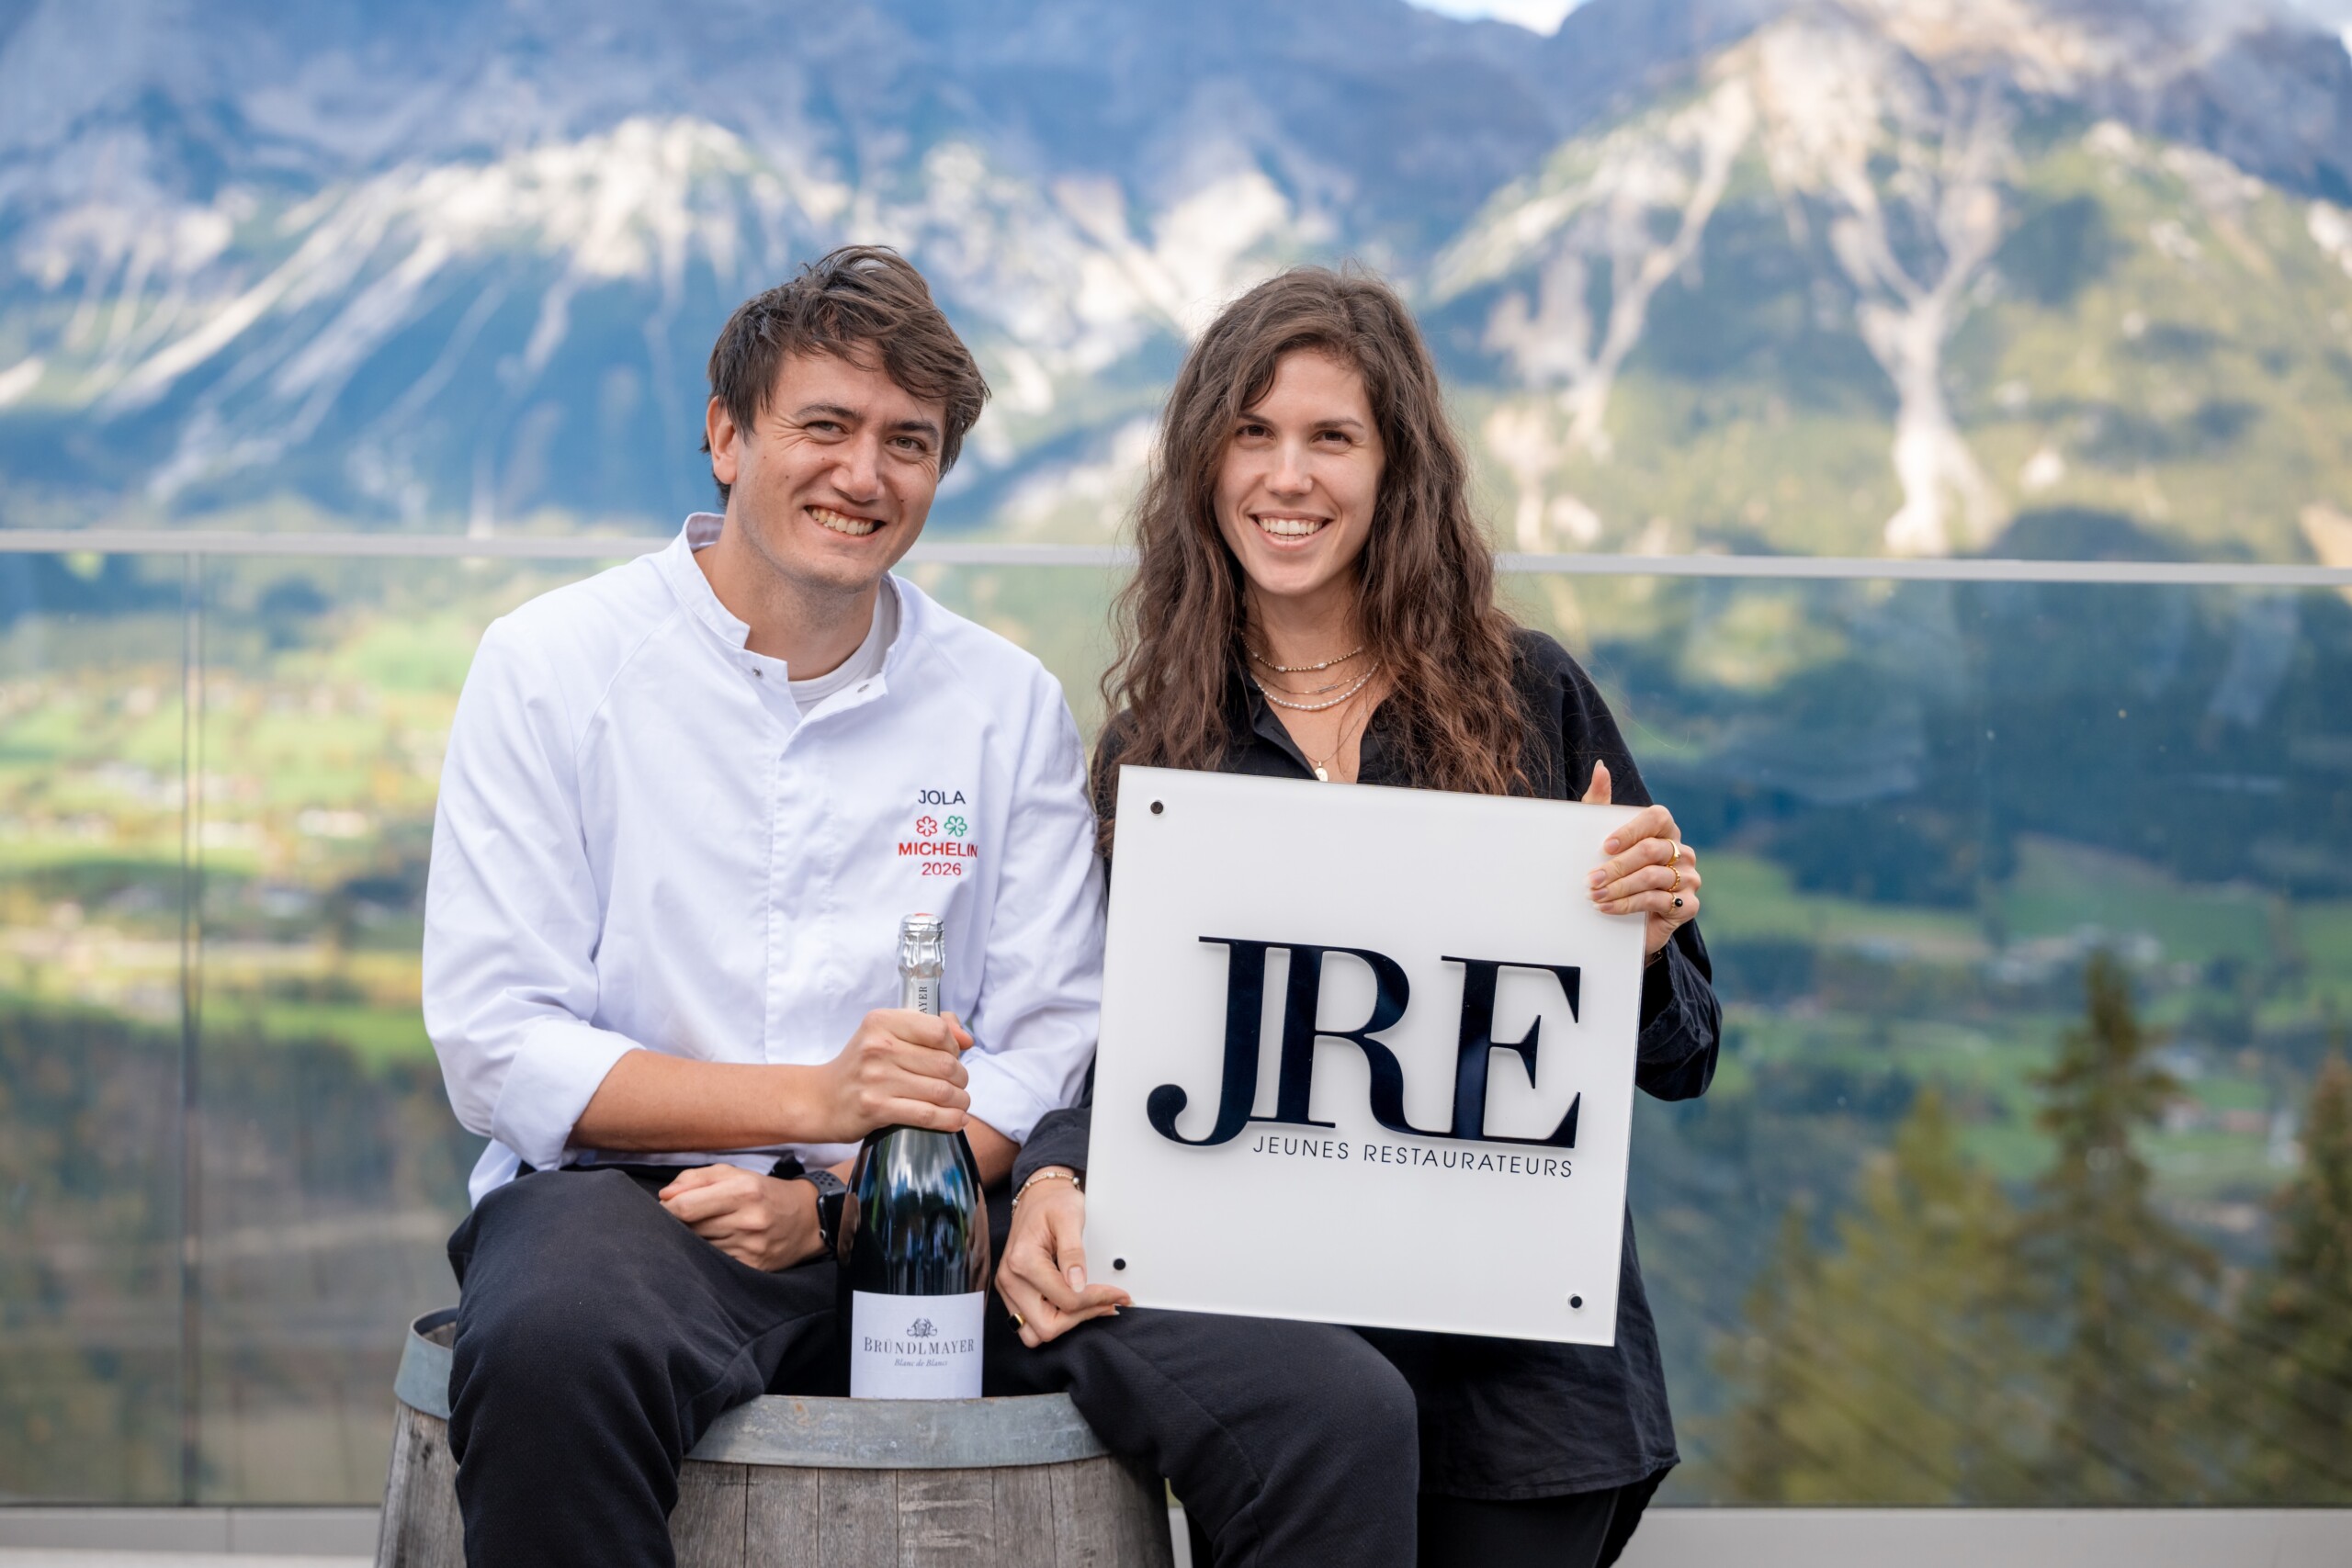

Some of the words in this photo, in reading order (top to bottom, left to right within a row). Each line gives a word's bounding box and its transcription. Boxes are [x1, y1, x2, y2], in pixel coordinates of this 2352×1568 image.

[918, 789, 966, 805] JOLA
[899, 841, 978, 858] MICHELIN
[922, 862, 962, 875] 2026
[1147, 936, 1581, 1148] JRE
[1253, 1135, 1350, 1159] JEUNES
[1363, 1145, 1573, 1178] RESTAURATEURS
[864, 1337, 975, 1355] BRÜNDLMAYER
[894, 1359, 914, 1367] Blanc
[916, 1359, 925, 1367] de
